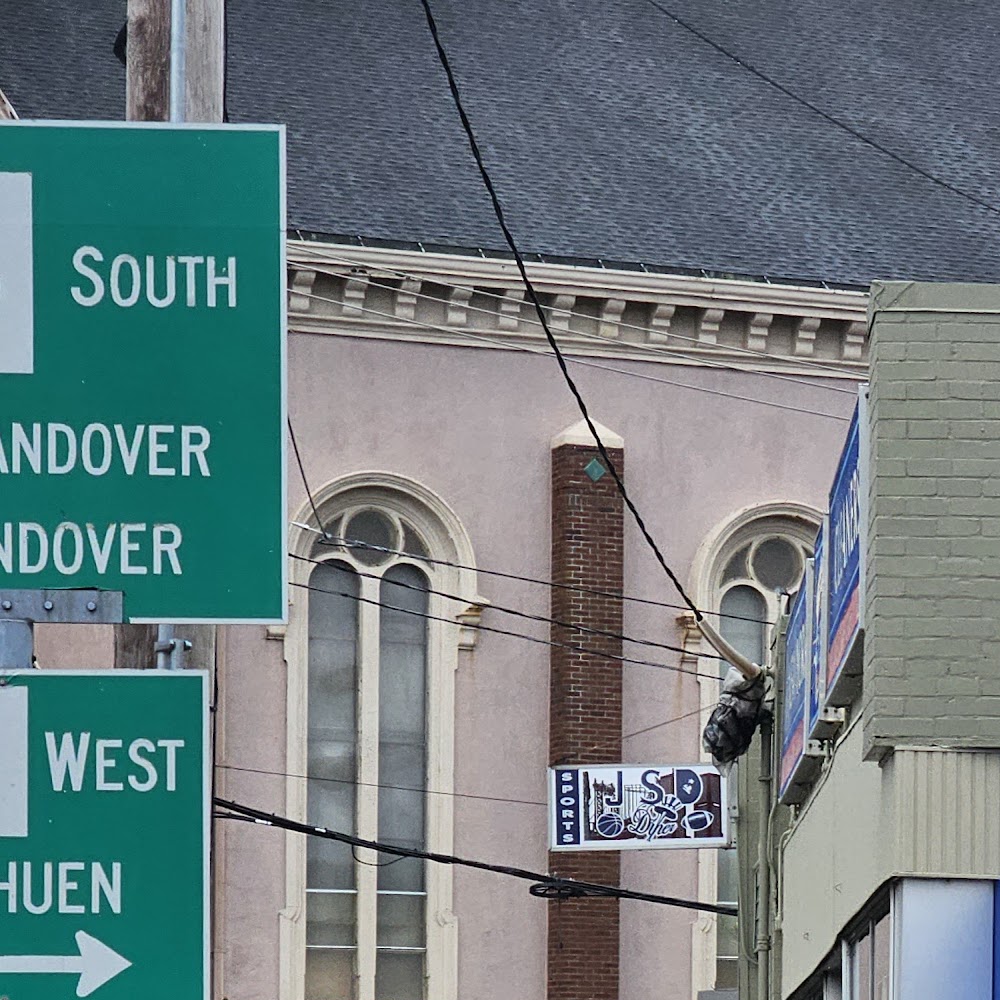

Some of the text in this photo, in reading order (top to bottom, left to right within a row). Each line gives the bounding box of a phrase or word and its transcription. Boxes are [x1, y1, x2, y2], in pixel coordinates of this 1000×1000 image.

[71, 245, 237, 308] SOUTH
[44, 731, 185, 792] WEST
[560, 772, 576, 843] SPORTS
